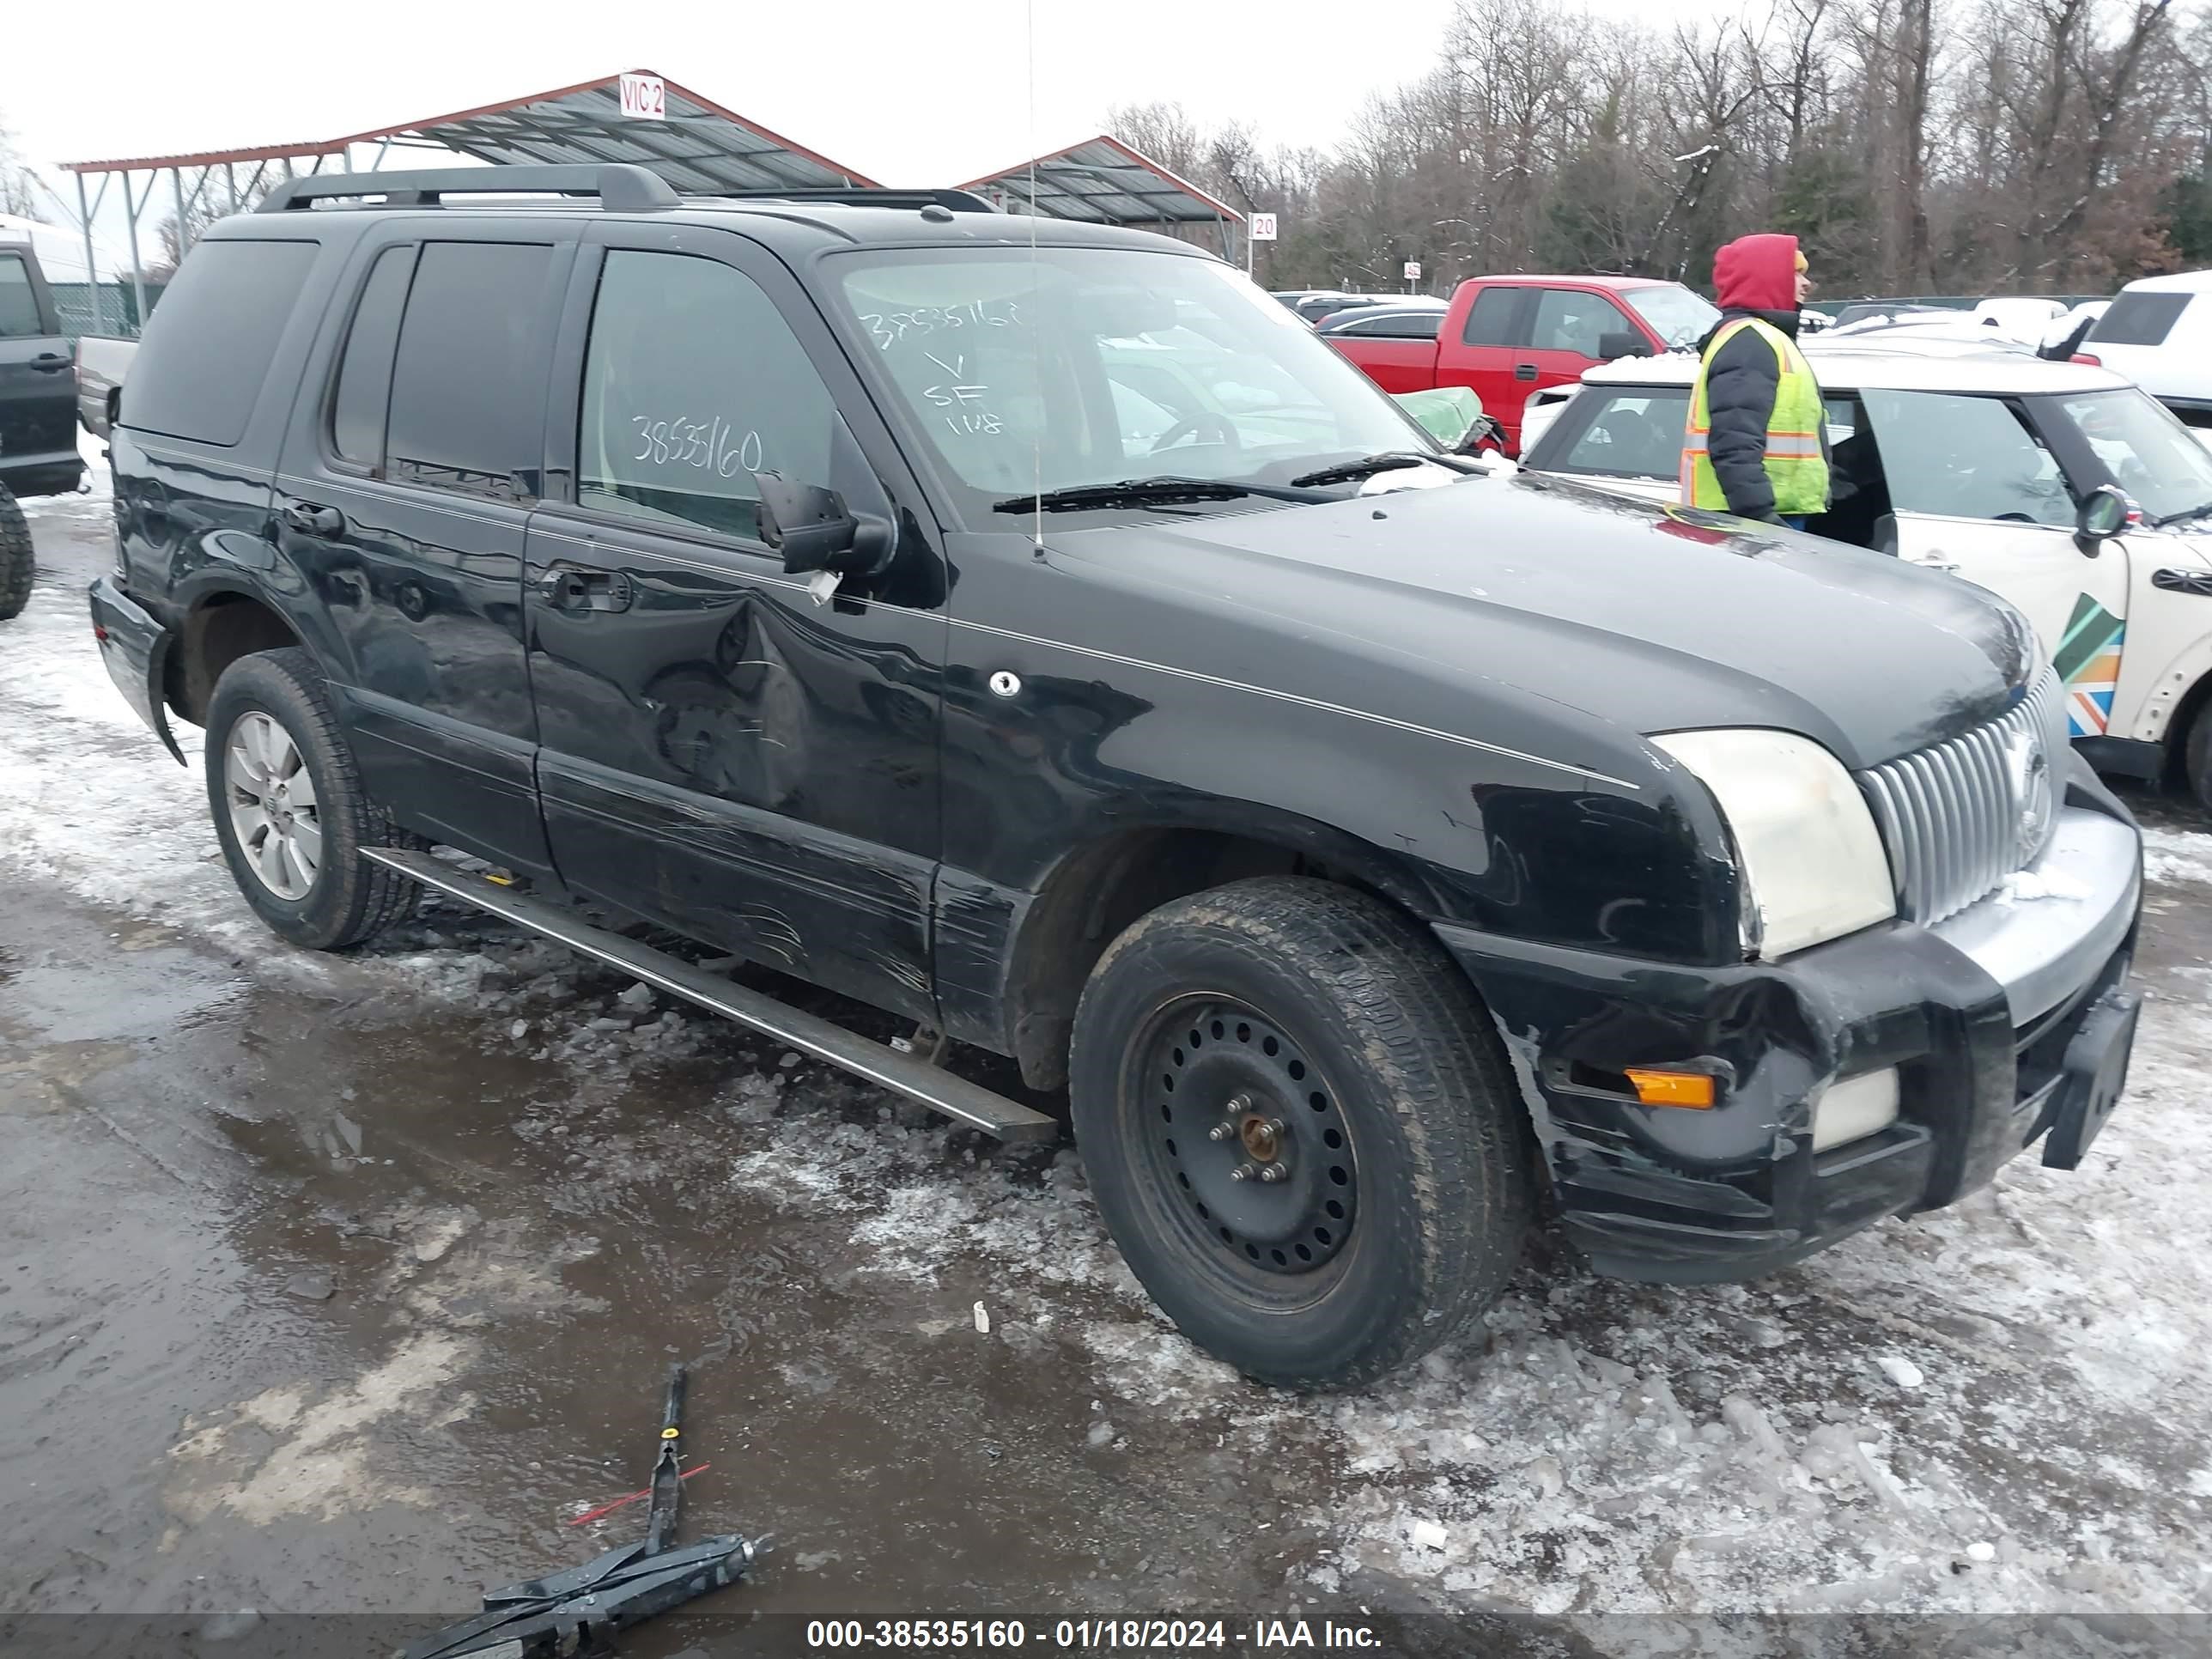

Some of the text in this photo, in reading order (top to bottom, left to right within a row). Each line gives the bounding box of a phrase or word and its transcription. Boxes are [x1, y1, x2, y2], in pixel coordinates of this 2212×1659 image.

[622, 79, 662, 113] VIC 2
[1255, 218, 1273, 234] 20
[923, 385, 989, 406] SF
